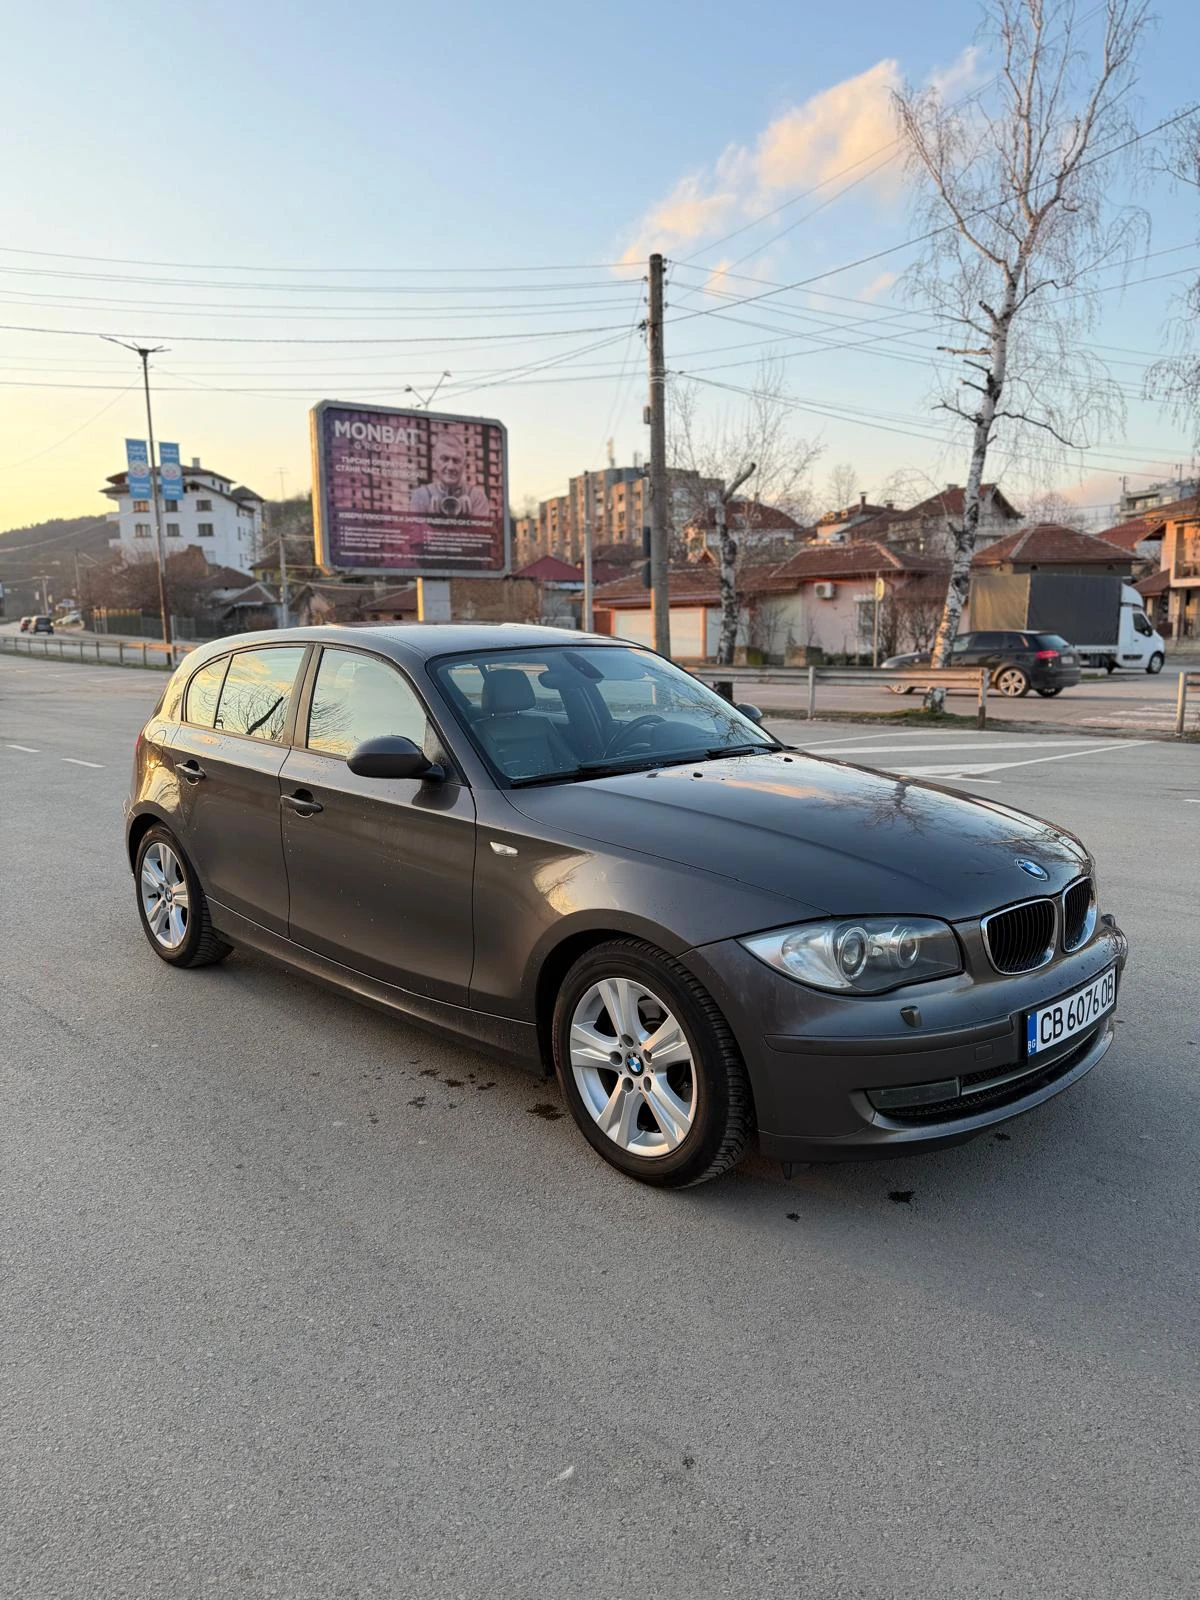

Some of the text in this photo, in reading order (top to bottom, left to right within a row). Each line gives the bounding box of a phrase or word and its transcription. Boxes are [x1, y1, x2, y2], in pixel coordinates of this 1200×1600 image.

[334, 420, 419, 446] MONBAT
[1041, 1006, 1063, 1044] CB
[1067, 985, 1099, 1030] 6076
[1027, 1040, 1036, 1050] BG
